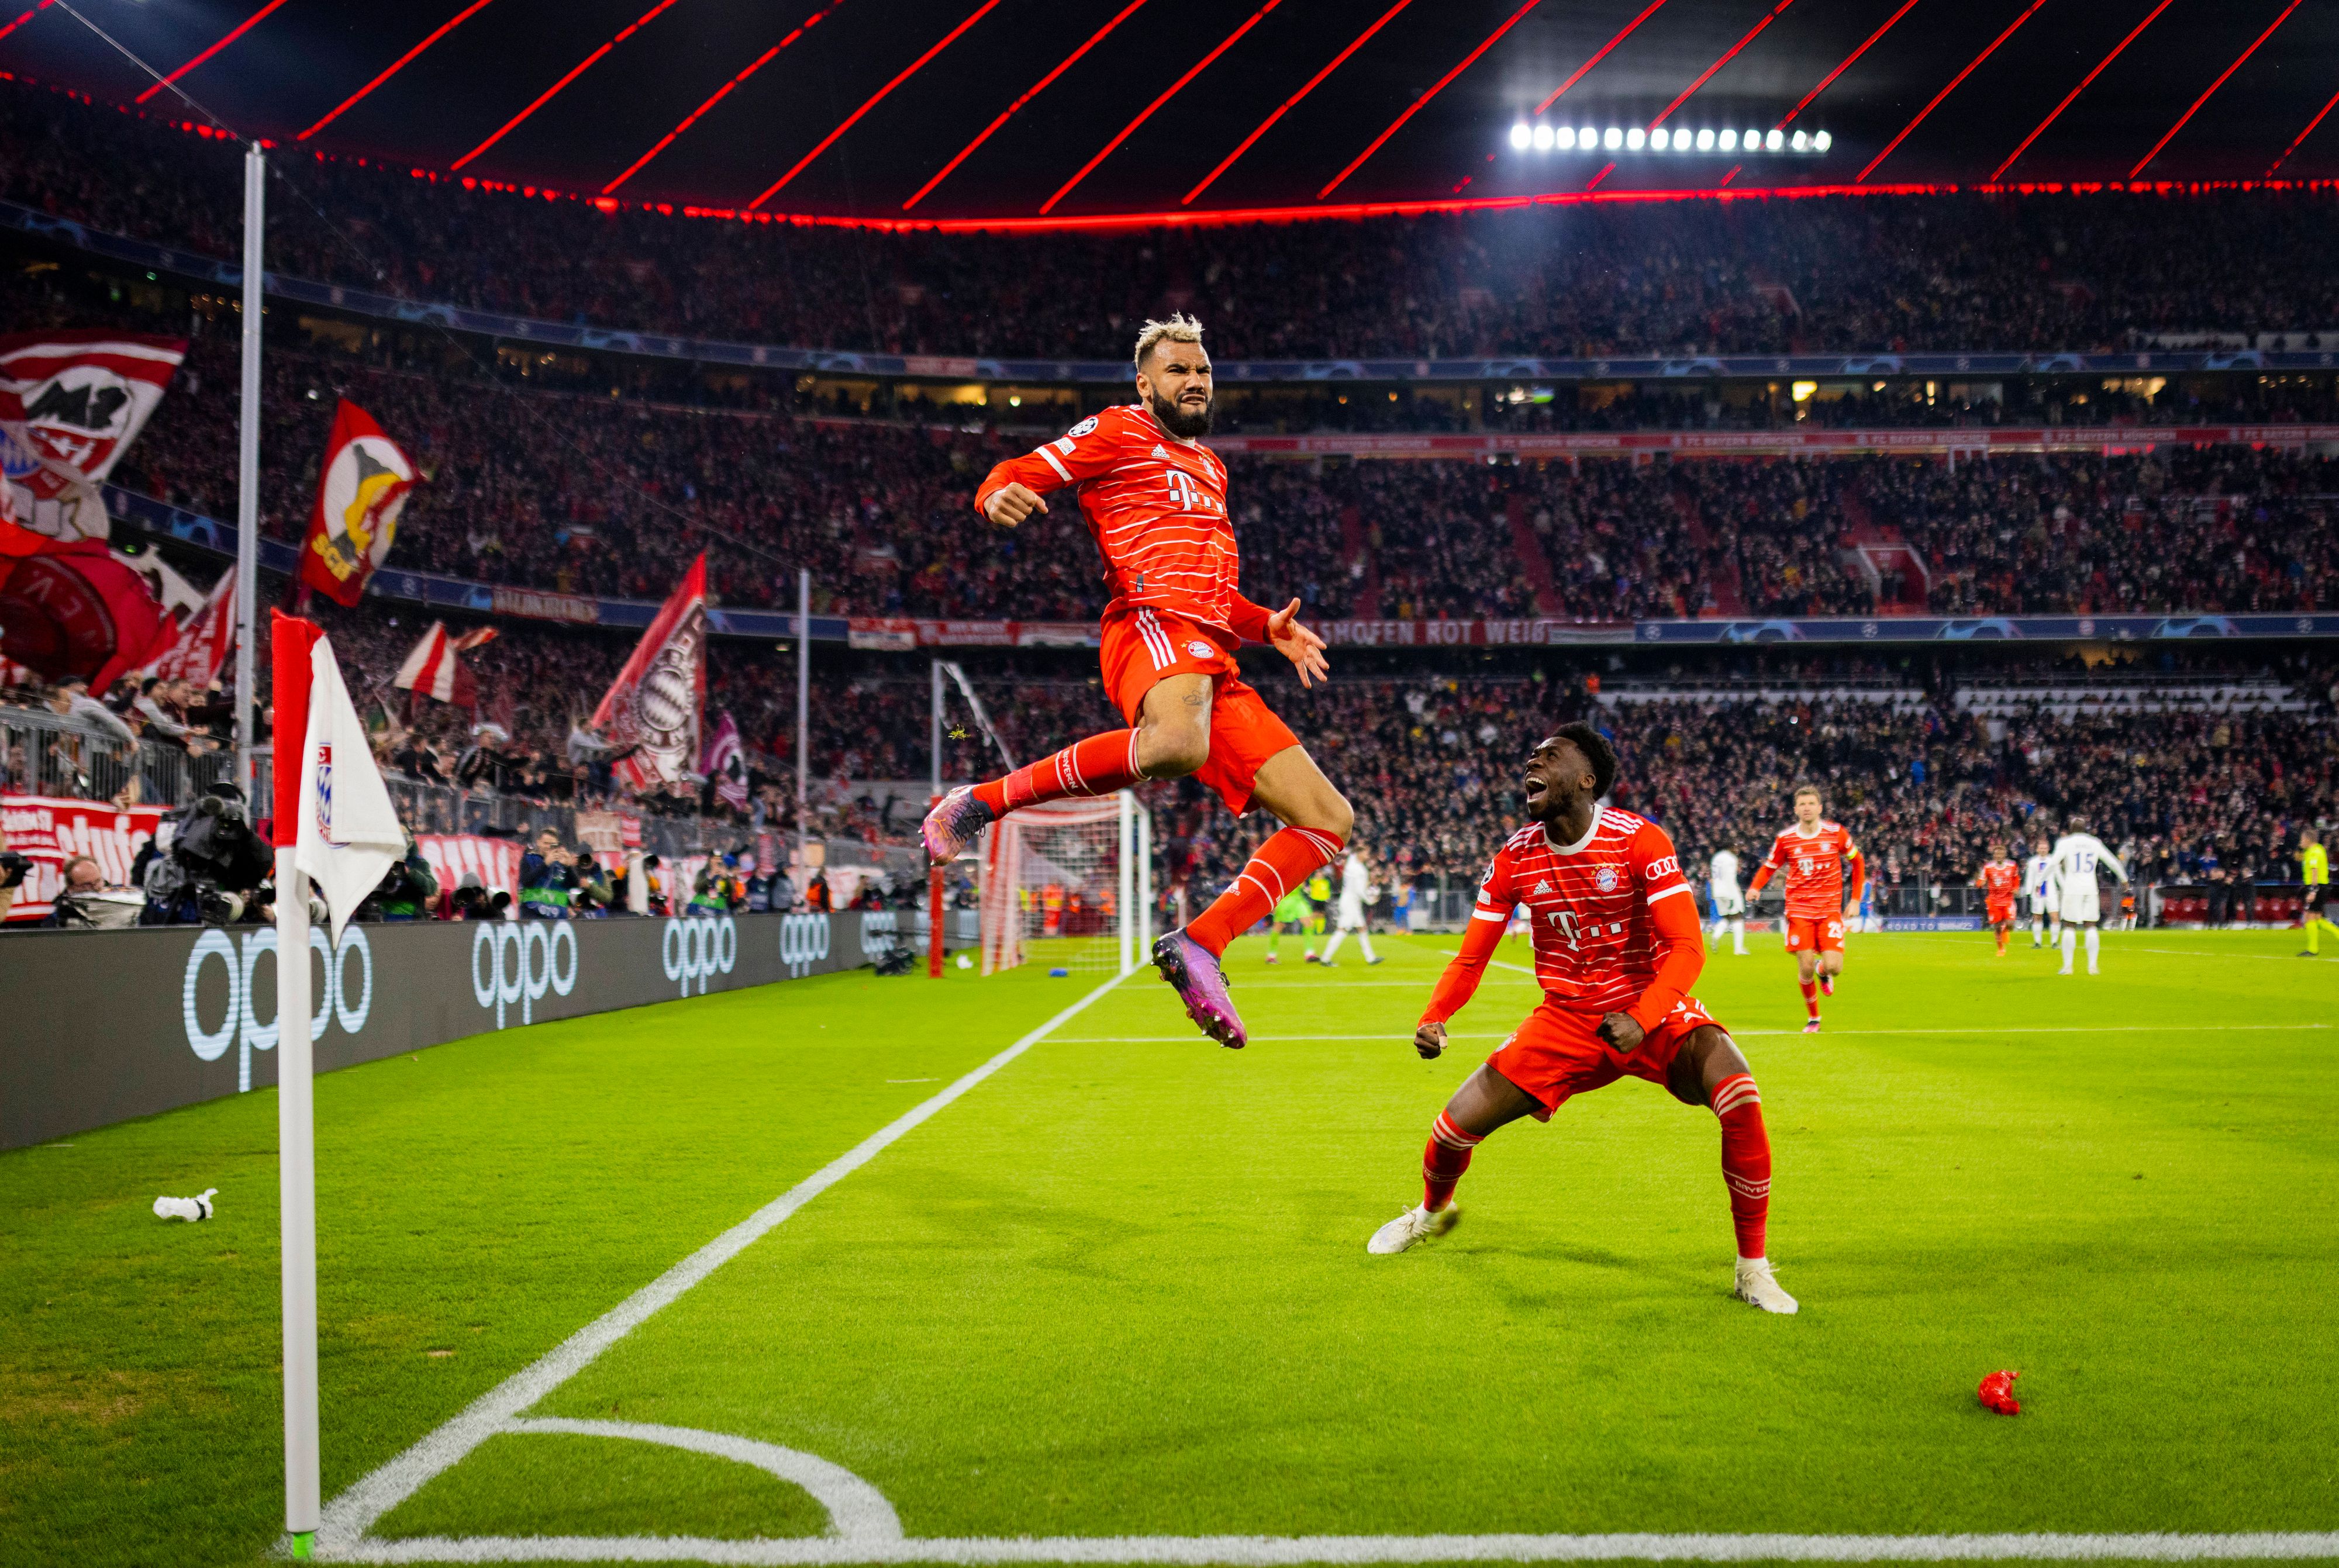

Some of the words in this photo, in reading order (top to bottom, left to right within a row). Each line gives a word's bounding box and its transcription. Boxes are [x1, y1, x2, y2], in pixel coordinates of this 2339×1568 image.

[1309, 623, 1415, 645] SHOFEN
[1426, 622, 1472, 644] ROT
[1062, 750, 1079, 790] BAYERN
[2073, 851, 2095, 873] 15
[1533, 887, 1553, 895] adidas
[1886, 922, 1918, 931] ROAD
[1920, 922, 1936, 930] TO
[663, 916, 737, 998] oppo
[779, 914, 830, 978] oppo
[472, 920, 578, 1030] oppo
